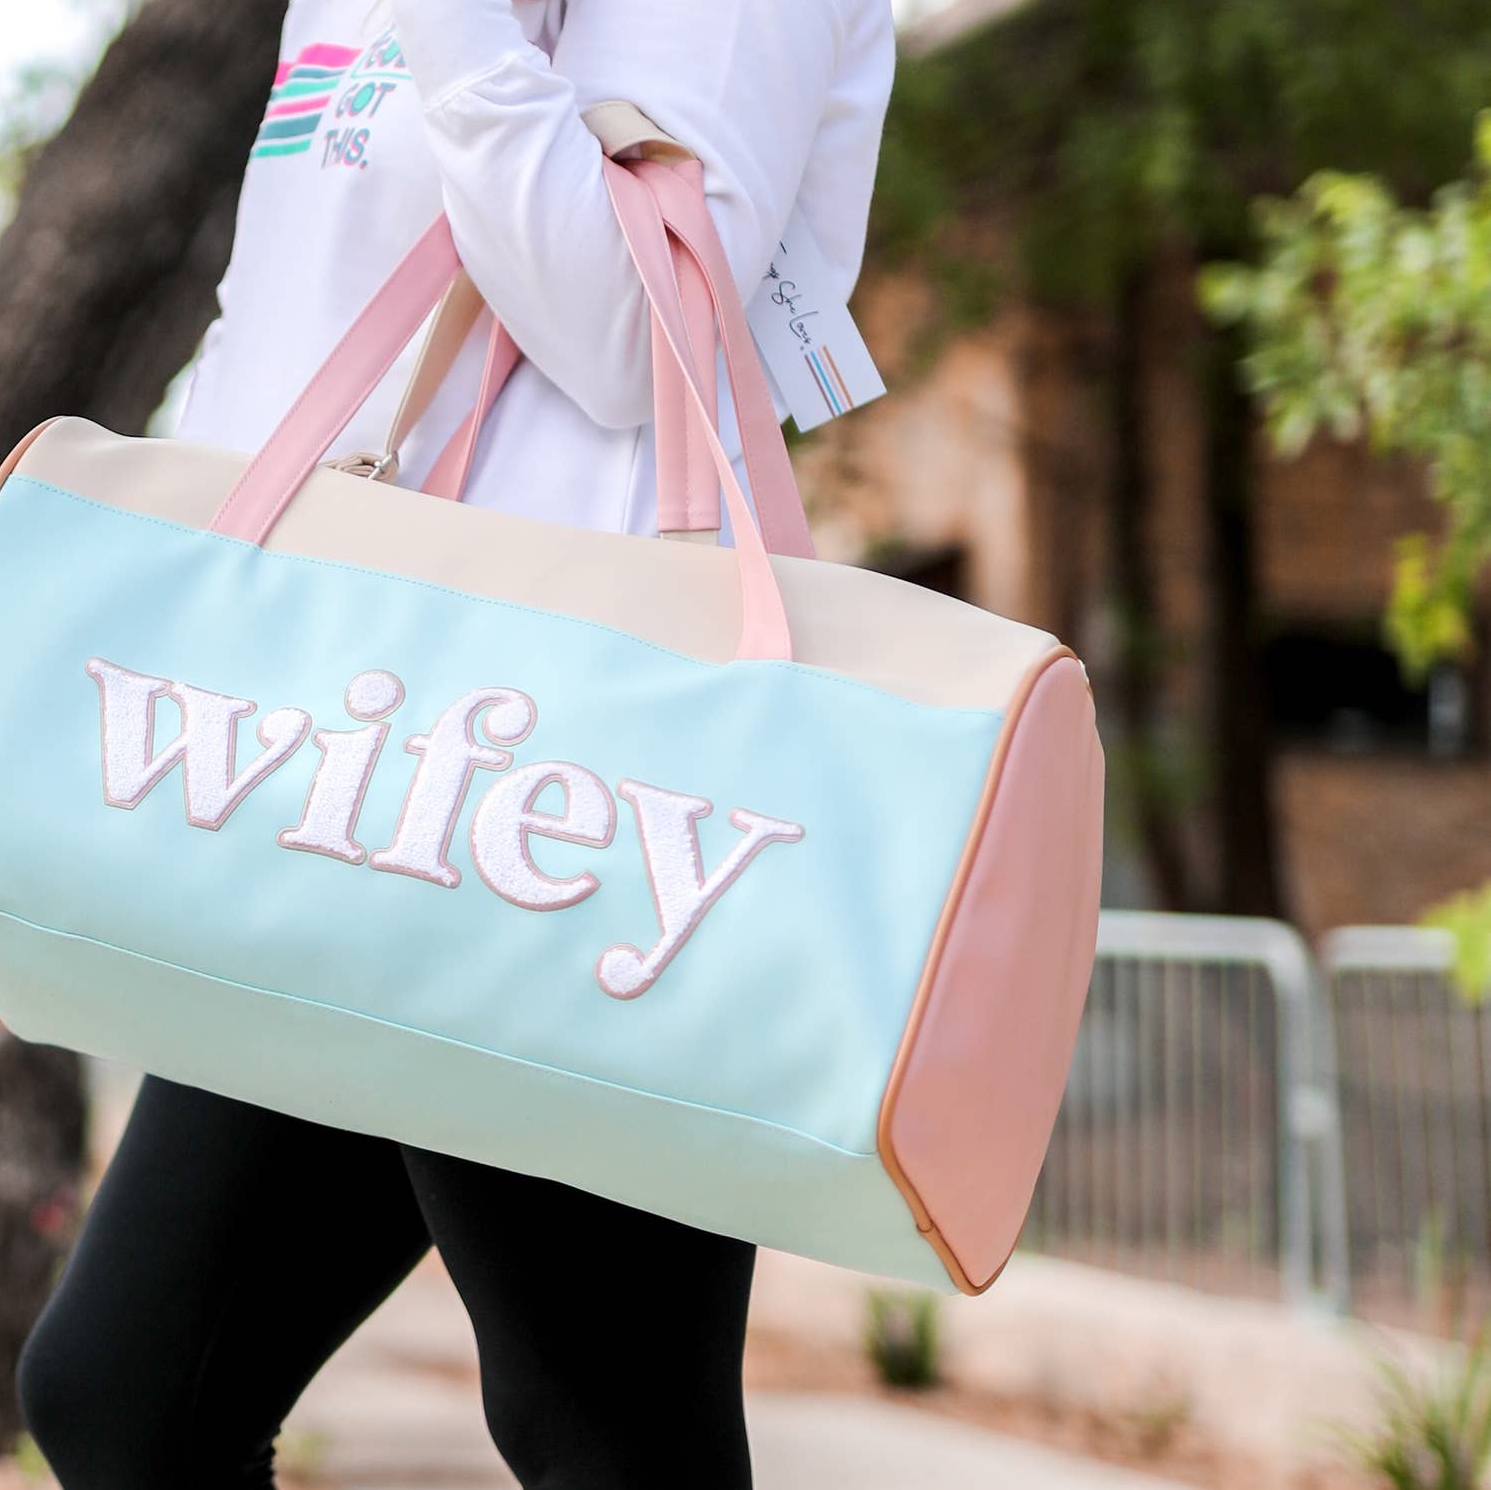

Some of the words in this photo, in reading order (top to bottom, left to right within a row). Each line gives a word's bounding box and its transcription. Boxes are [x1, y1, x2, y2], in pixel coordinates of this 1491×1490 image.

[335, 82, 397, 119] GOT
[321, 127, 371, 170] THIS.
[85, 657, 805, 1001] wifey
